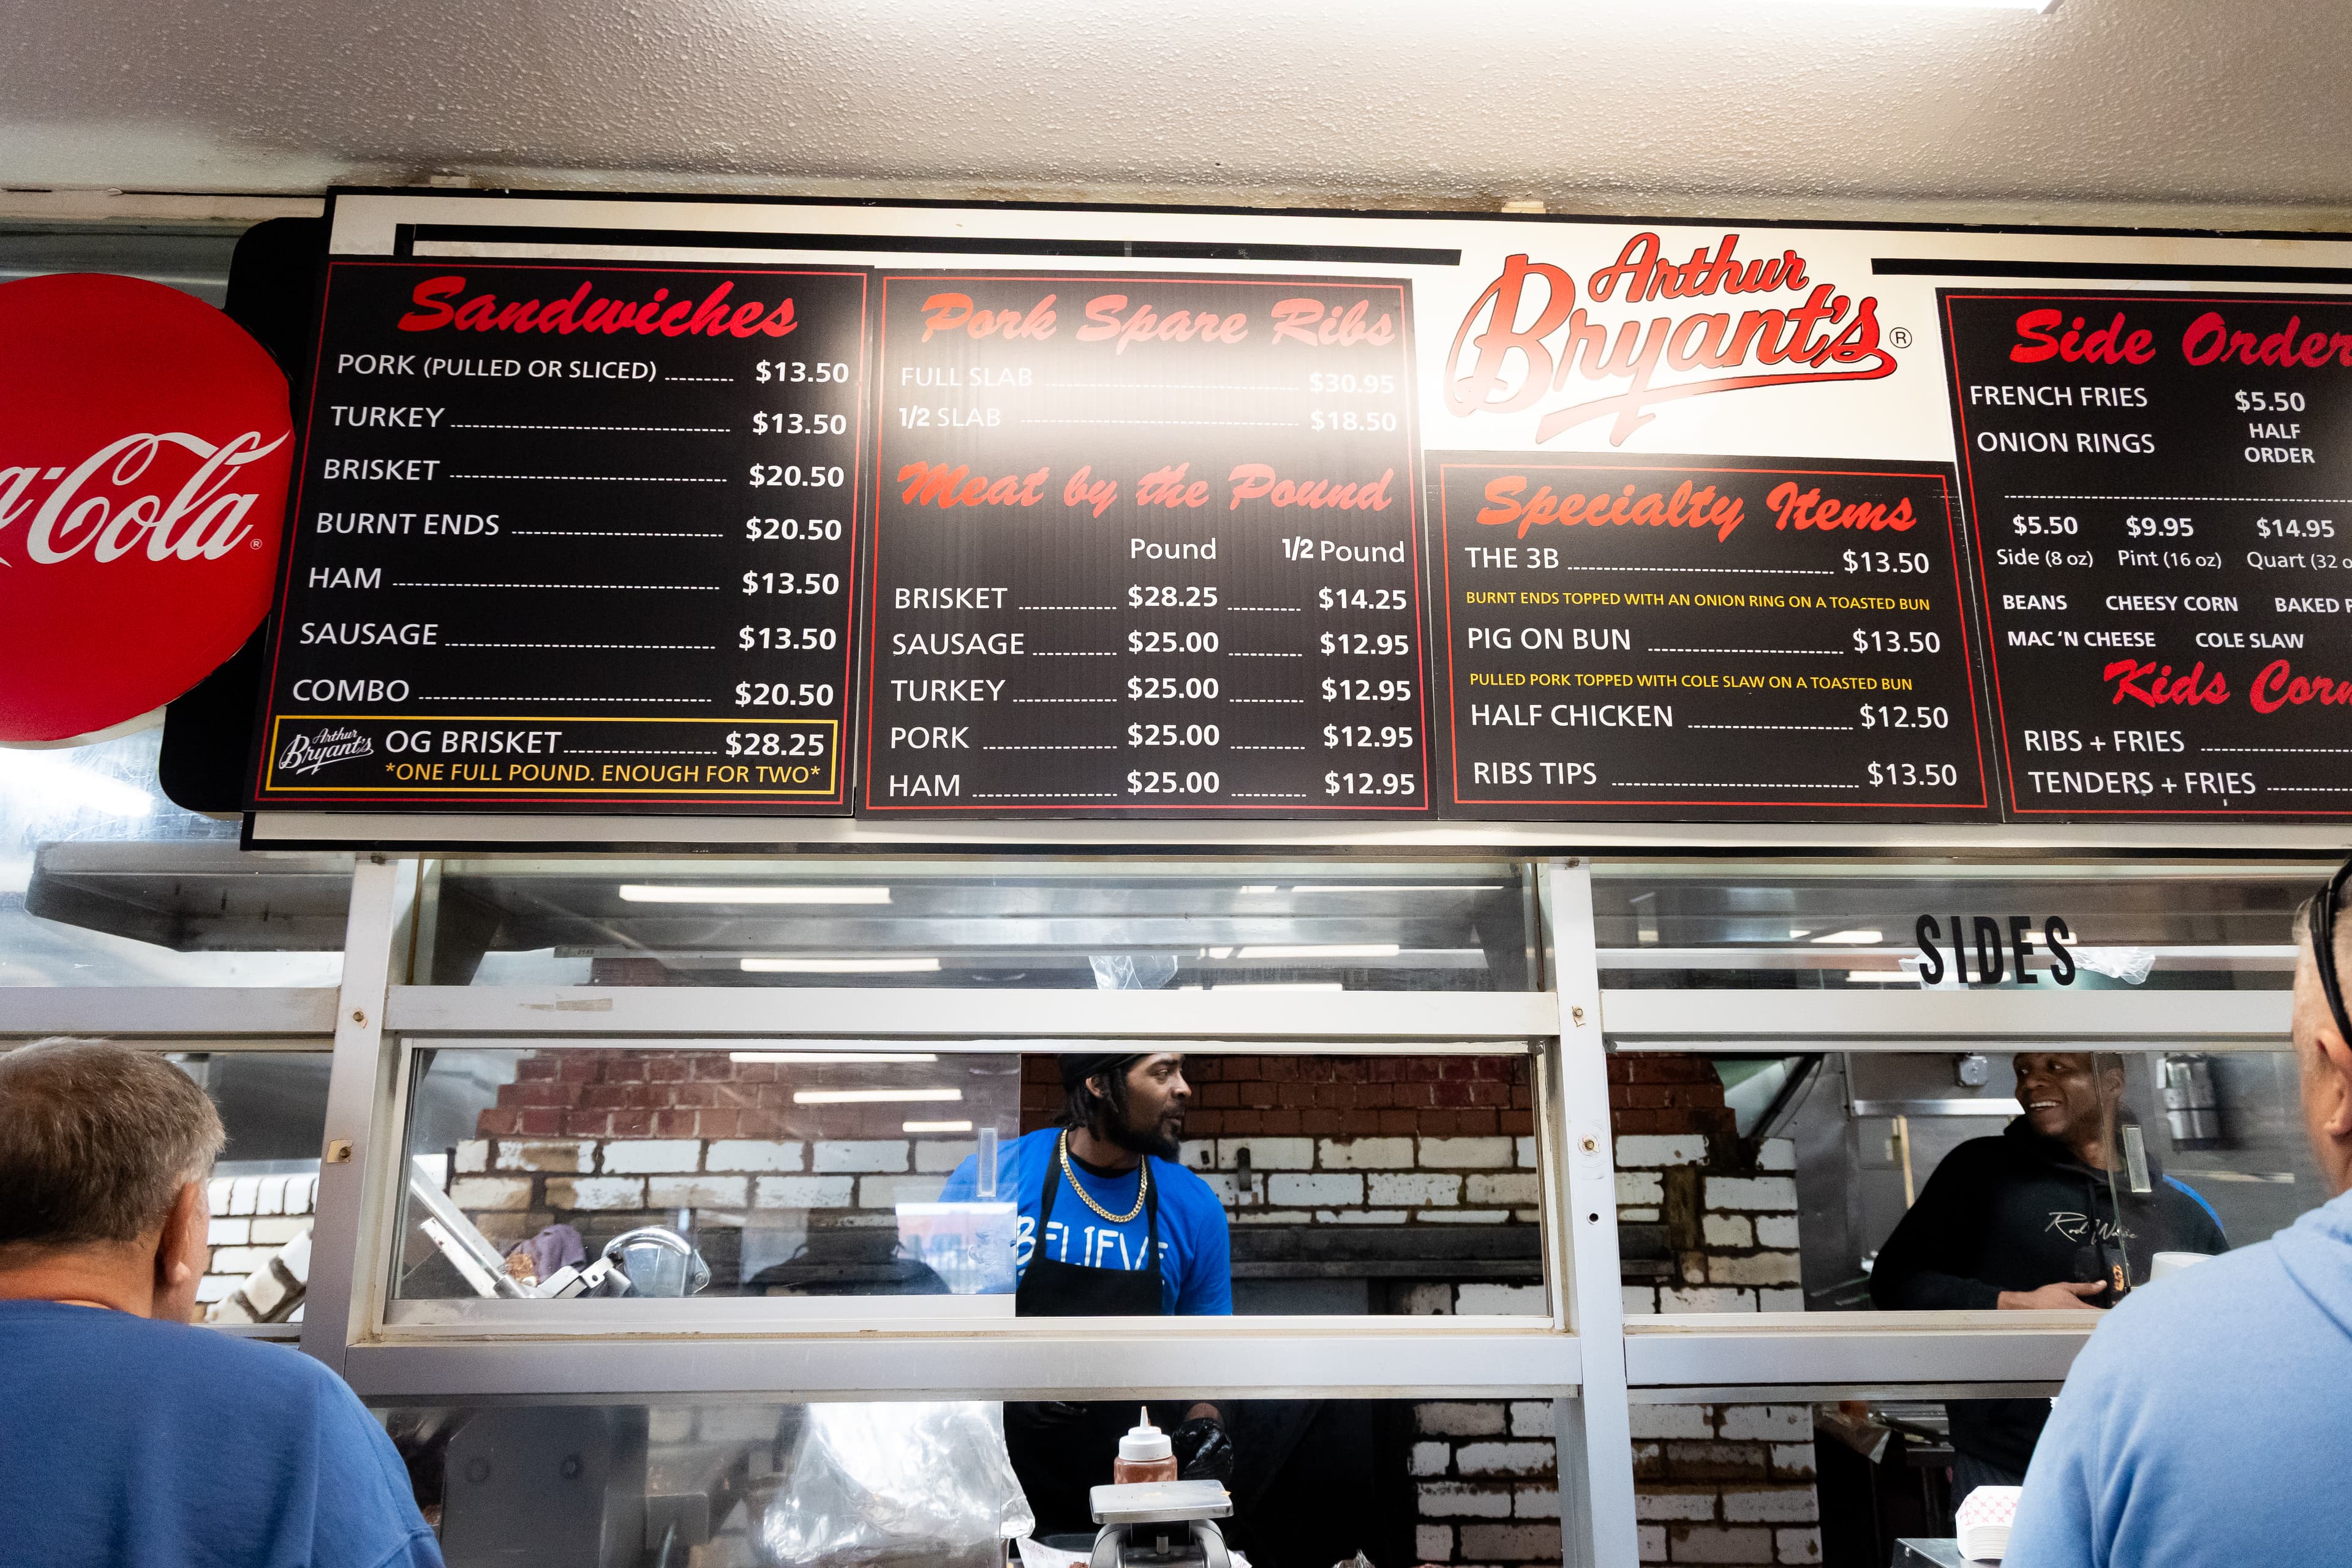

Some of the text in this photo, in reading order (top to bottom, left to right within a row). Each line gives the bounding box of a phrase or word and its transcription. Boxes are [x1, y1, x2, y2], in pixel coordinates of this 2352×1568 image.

[1588, 231, 1810, 303] Arthur
[398, 276, 797, 337] Sandwiches
[921, 293, 1395, 355] Pork Spare Ribs
[1443, 252, 1898, 448] Bryant's
[2010, 309, 2352, 367] Side Order
[338, 355, 850, 384] PORK (PULLED OR SLICED) $13.50
[901, 368, 1395, 395] FULL SLAB $30.95
[1970, 386, 2305, 412] FRENCH FRIES $5.50
[331, 407, 848, 435] TURKEY $13.50
[899, 407, 1398, 432] 1/2 SLAB $18.50
[2249, 423, 2300, 439] HALF
[1978, 432, 2154, 453] ONION RINGS
[2245, 447, 2315, 463] ORDER
[324, 459, 844, 488] BRISKET $20.50
[896, 460, 1393, 519] Meat by the Pound
[1477, 476, 1916, 543] Specialty Items
[317, 513, 841, 541] BURNT ENDS $20.50
[2013, 514, 2334, 538] $5.50 $9.95 $14.95
[1131, 537, 1404, 562] Pound 1/2 Pound
[1465, 548, 1929, 573] THE 3B $13.50
[1997, 548, 2039, 565] Side
[2046, 551, 2062, 567] (8
[2067, 551, 2093, 567] oz)
[2119, 551, 2158, 565] Pint
[2164, 552, 2190, 568] (16
[2196, 552, 2221, 568] oz)
[2247, 552, 2305, 570] Quart
[2311, 554, 2337, 570] (32
[309, 568, 839, 595] HAM $13.50
[896, 584, 1406, 610] BRISKET $28.25 $14.25
[1467, 592, 1929, 610] BURNT ENDS TOPPED WITH AN ONION RING ON A TOASTED BUN
[2003, 595, 2067, 609] BEANS
[2106, 596, 2177, 611] CHEESY
[2184, 597, 2238, 611] CORN
[2275, 598, 2339, 612] BAKED
[300, 623, 836, 650] SAUSAGE $13.50
[893, 630, 1408, 656] SAUSAGE $25.00 $12.95
[1469, 628, 1940, 654] PIG ON BUN $13.50
[2008, 631, 2054, 646] MAC
[2084, 632, 2155, 647] CHEESE
[2196, 633, 2244, 647] COLE
[2250, 633, 2303, 648] SLAW
[293, 680, 833, 707] COMBO $20.50
[891, 676, 1411, 702] TURKEY $25.00 $12.95
[1471, 674, 1912, 690] PULLED PORK TOPPED WITH COLE SLAW ON A TOASTED BUN
[2104, 659, 2230, 707] Kids
[1472, 704, 1948, 729] HALF CHICKEN $12.50
[312, 726, 358, 744] Arthur
[386, 731, 823, 757] OG BRISKET $28.25
[892, 723, 1412, 748] PORK $25.00 $12.95
[2025, 731, 2184, 752] RIBS + FRIES
[279, 734, 374, 775] Bryant's
[451, 764, 502, 780] FULL
[510, 764, 594, 781] POUND.
[603, 765, 698, 782] ENOUGH
[707, 766, 748, 782] FOR
[890, 769, 1414, 796] HAM $25.00 $12.95
[1474, 761, 1956, 787] RIBS TIPS $13.50
[2028, 772, 2255, 794] TENDERS + FRIES
[1915, 913, 2076, 986] SIDES
